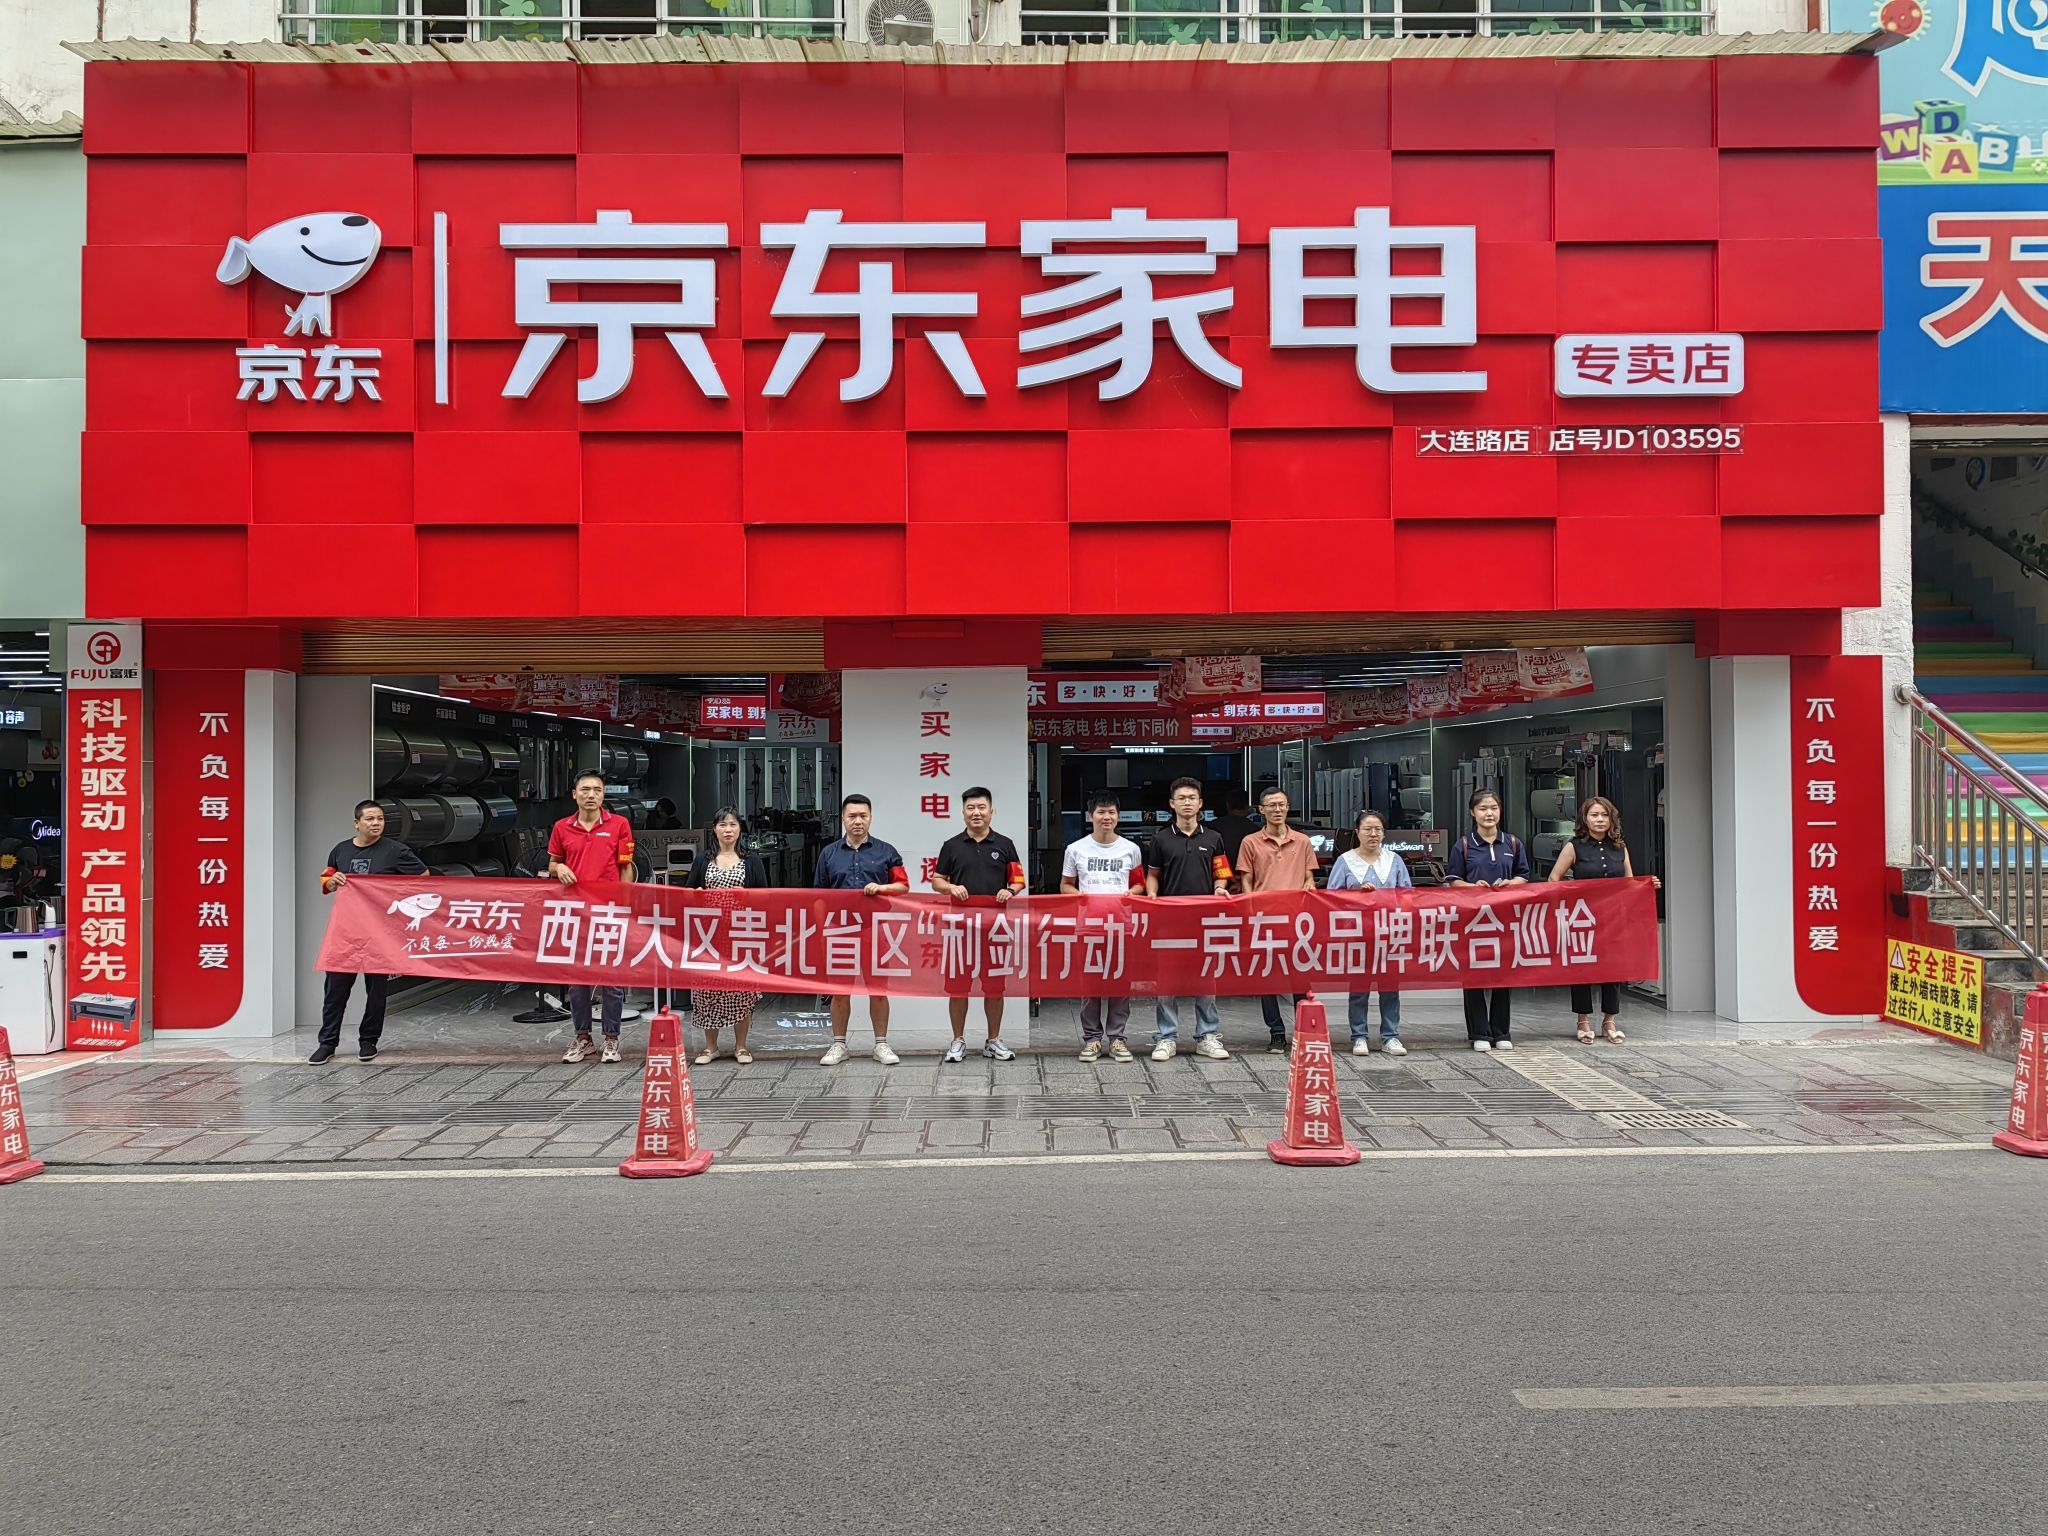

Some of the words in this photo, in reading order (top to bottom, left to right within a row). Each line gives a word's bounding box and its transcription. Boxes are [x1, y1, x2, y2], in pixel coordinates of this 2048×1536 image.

[499, 206, 1488, 403] 京东家电
[236, 344, 382, 402] 京东
[1572, 343, 1730, 385] 专卖店
[1420, 429, 1530, 453] 大连路店
[1548, 427, 1741, 452] 店号JD103595
[80, 698, 127, 831] 科技驱动
[1033, 719, 1090, 737] 京东家电
[1094, 718, 1179, 737] 线上线下同价
[198, 712, 229, 970] 不负每一份热爱
[1806, 697, 1839, 952] 不负每一份热爱
[80, 848, 127, 982] 产品领先
[401, 933, 516, 952] 不负每一份热爱
[445, 899, 525, 930] 京东
[1907, 947, 1976, 989] 安全提示
[643, 1054, 673, 1155] 京东家电
[1303, 1039, 1331, 1144] 京东家电
[2011, 1027, 2036, 1131] 京东家电
